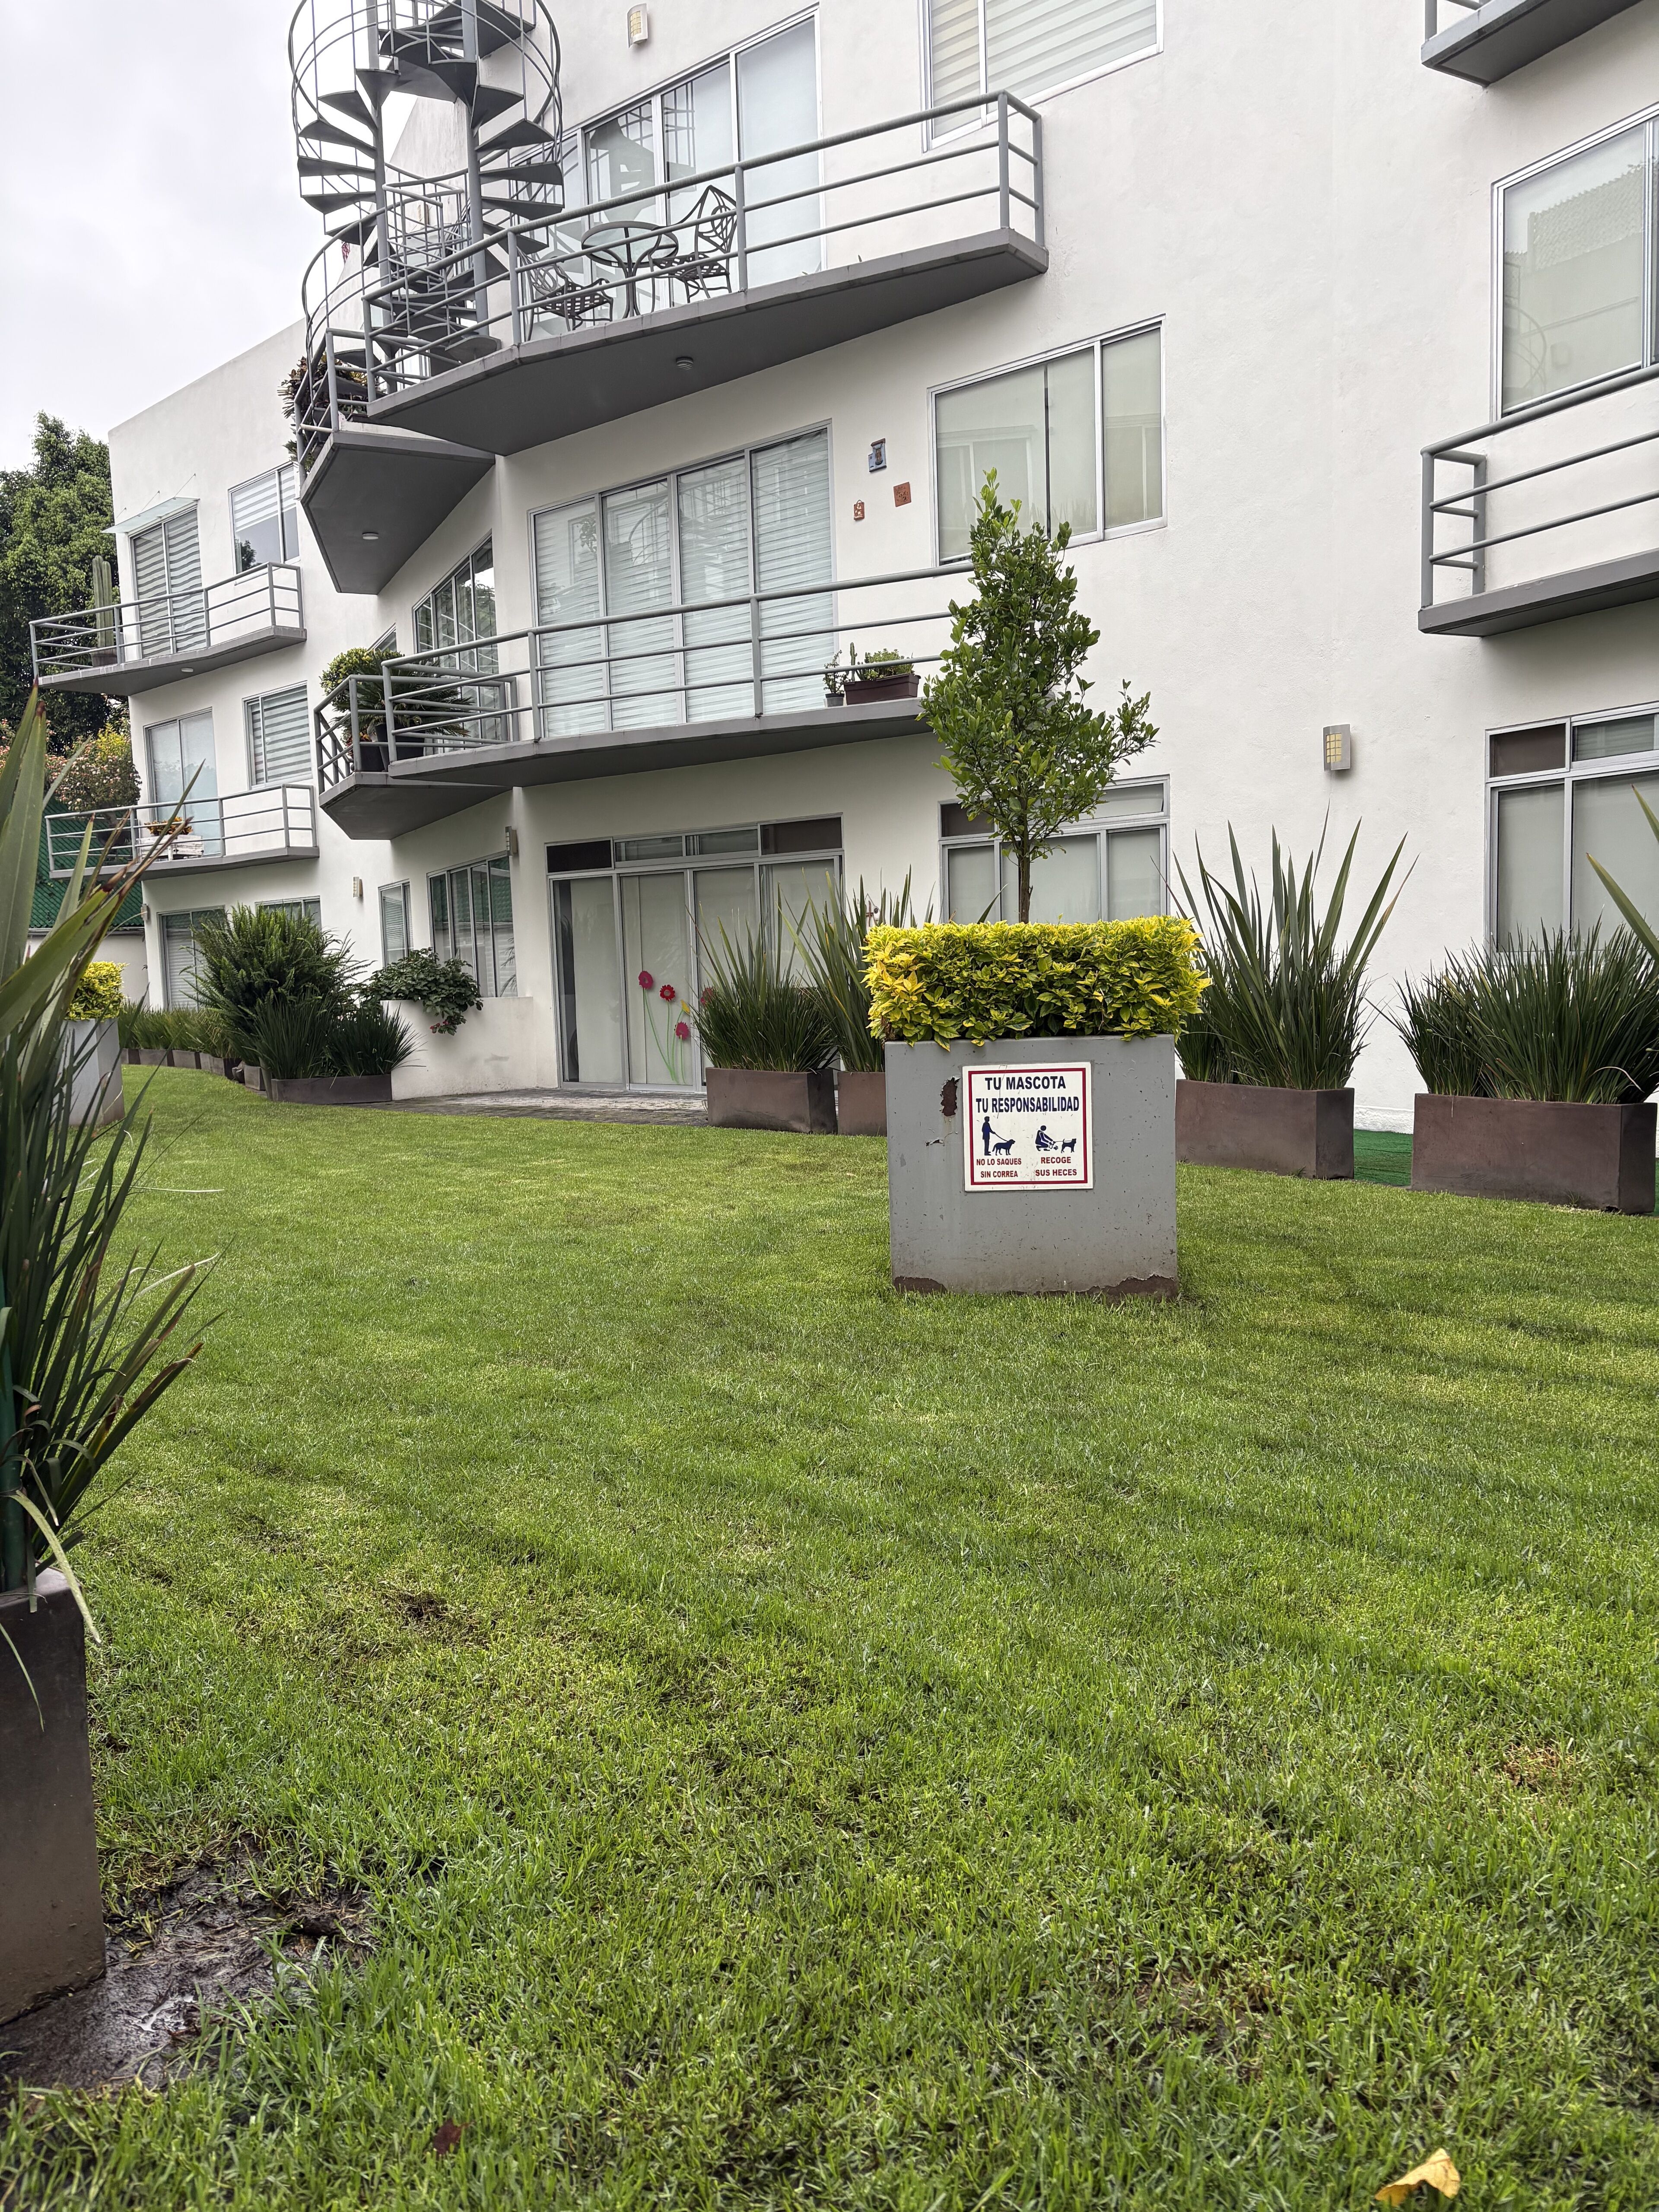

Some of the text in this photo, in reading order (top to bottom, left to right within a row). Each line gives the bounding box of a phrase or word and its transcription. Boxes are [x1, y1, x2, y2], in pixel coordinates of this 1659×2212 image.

[985, 1076, 1066, 1090] TU MASCOTA
[976, 1096, 1079, 1113] TU RESPONSABILIDAD
